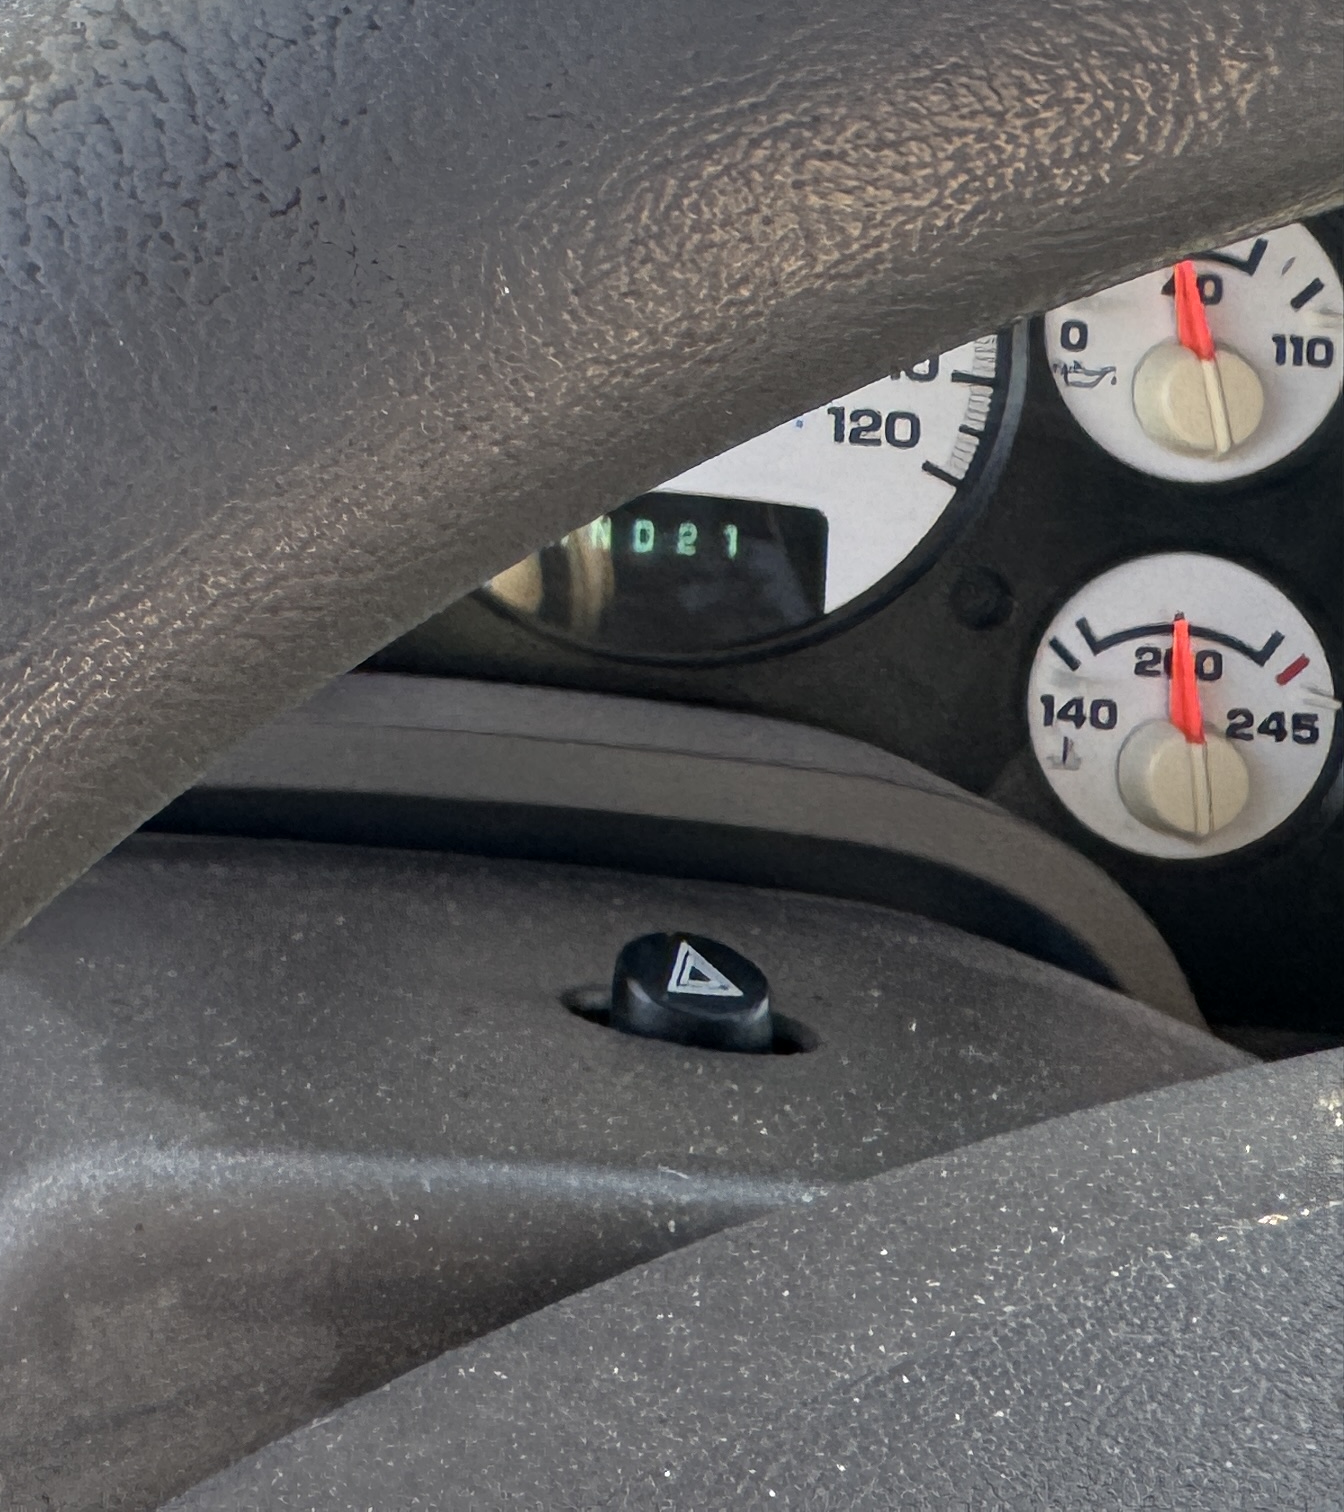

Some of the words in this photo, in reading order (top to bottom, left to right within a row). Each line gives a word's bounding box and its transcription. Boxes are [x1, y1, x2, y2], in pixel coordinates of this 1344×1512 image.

[1060, 319, 1089, 352] 0
[1271, 333, 1335, 369] 110
[827, 406, 921, 449] 120
[1040, 693, 1118, 730] 140
[1226, 707, 1319, 745] 245
